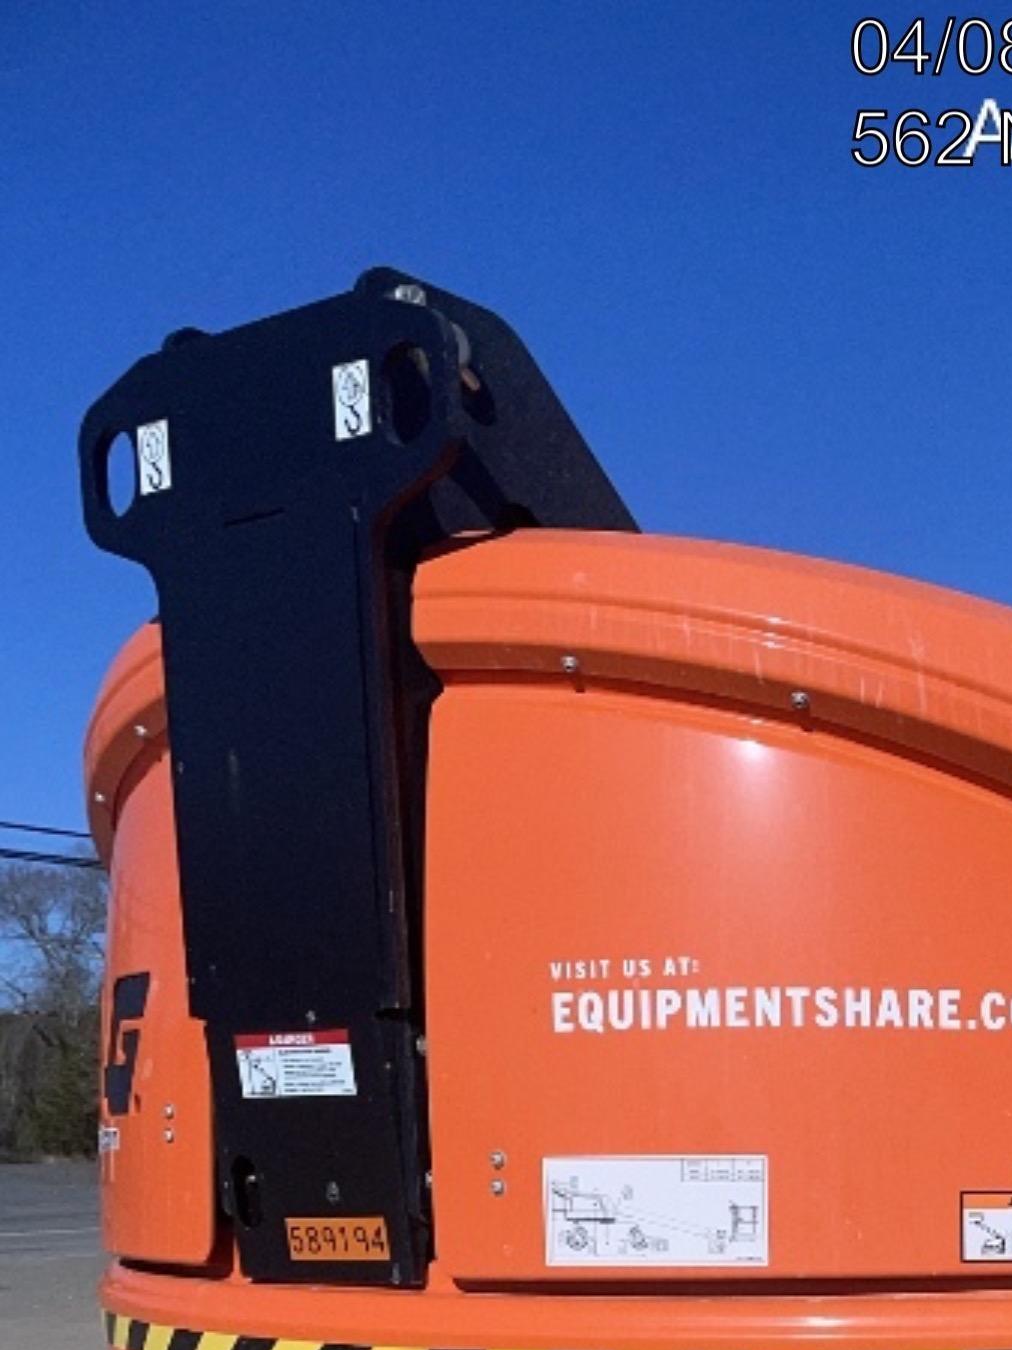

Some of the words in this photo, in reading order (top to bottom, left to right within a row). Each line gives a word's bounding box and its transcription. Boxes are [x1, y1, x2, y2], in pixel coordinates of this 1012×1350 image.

[550, 959, 611, 981] VISIT
[622, 958, 653, 978] US
[662, 956, 700, 977] AT:
